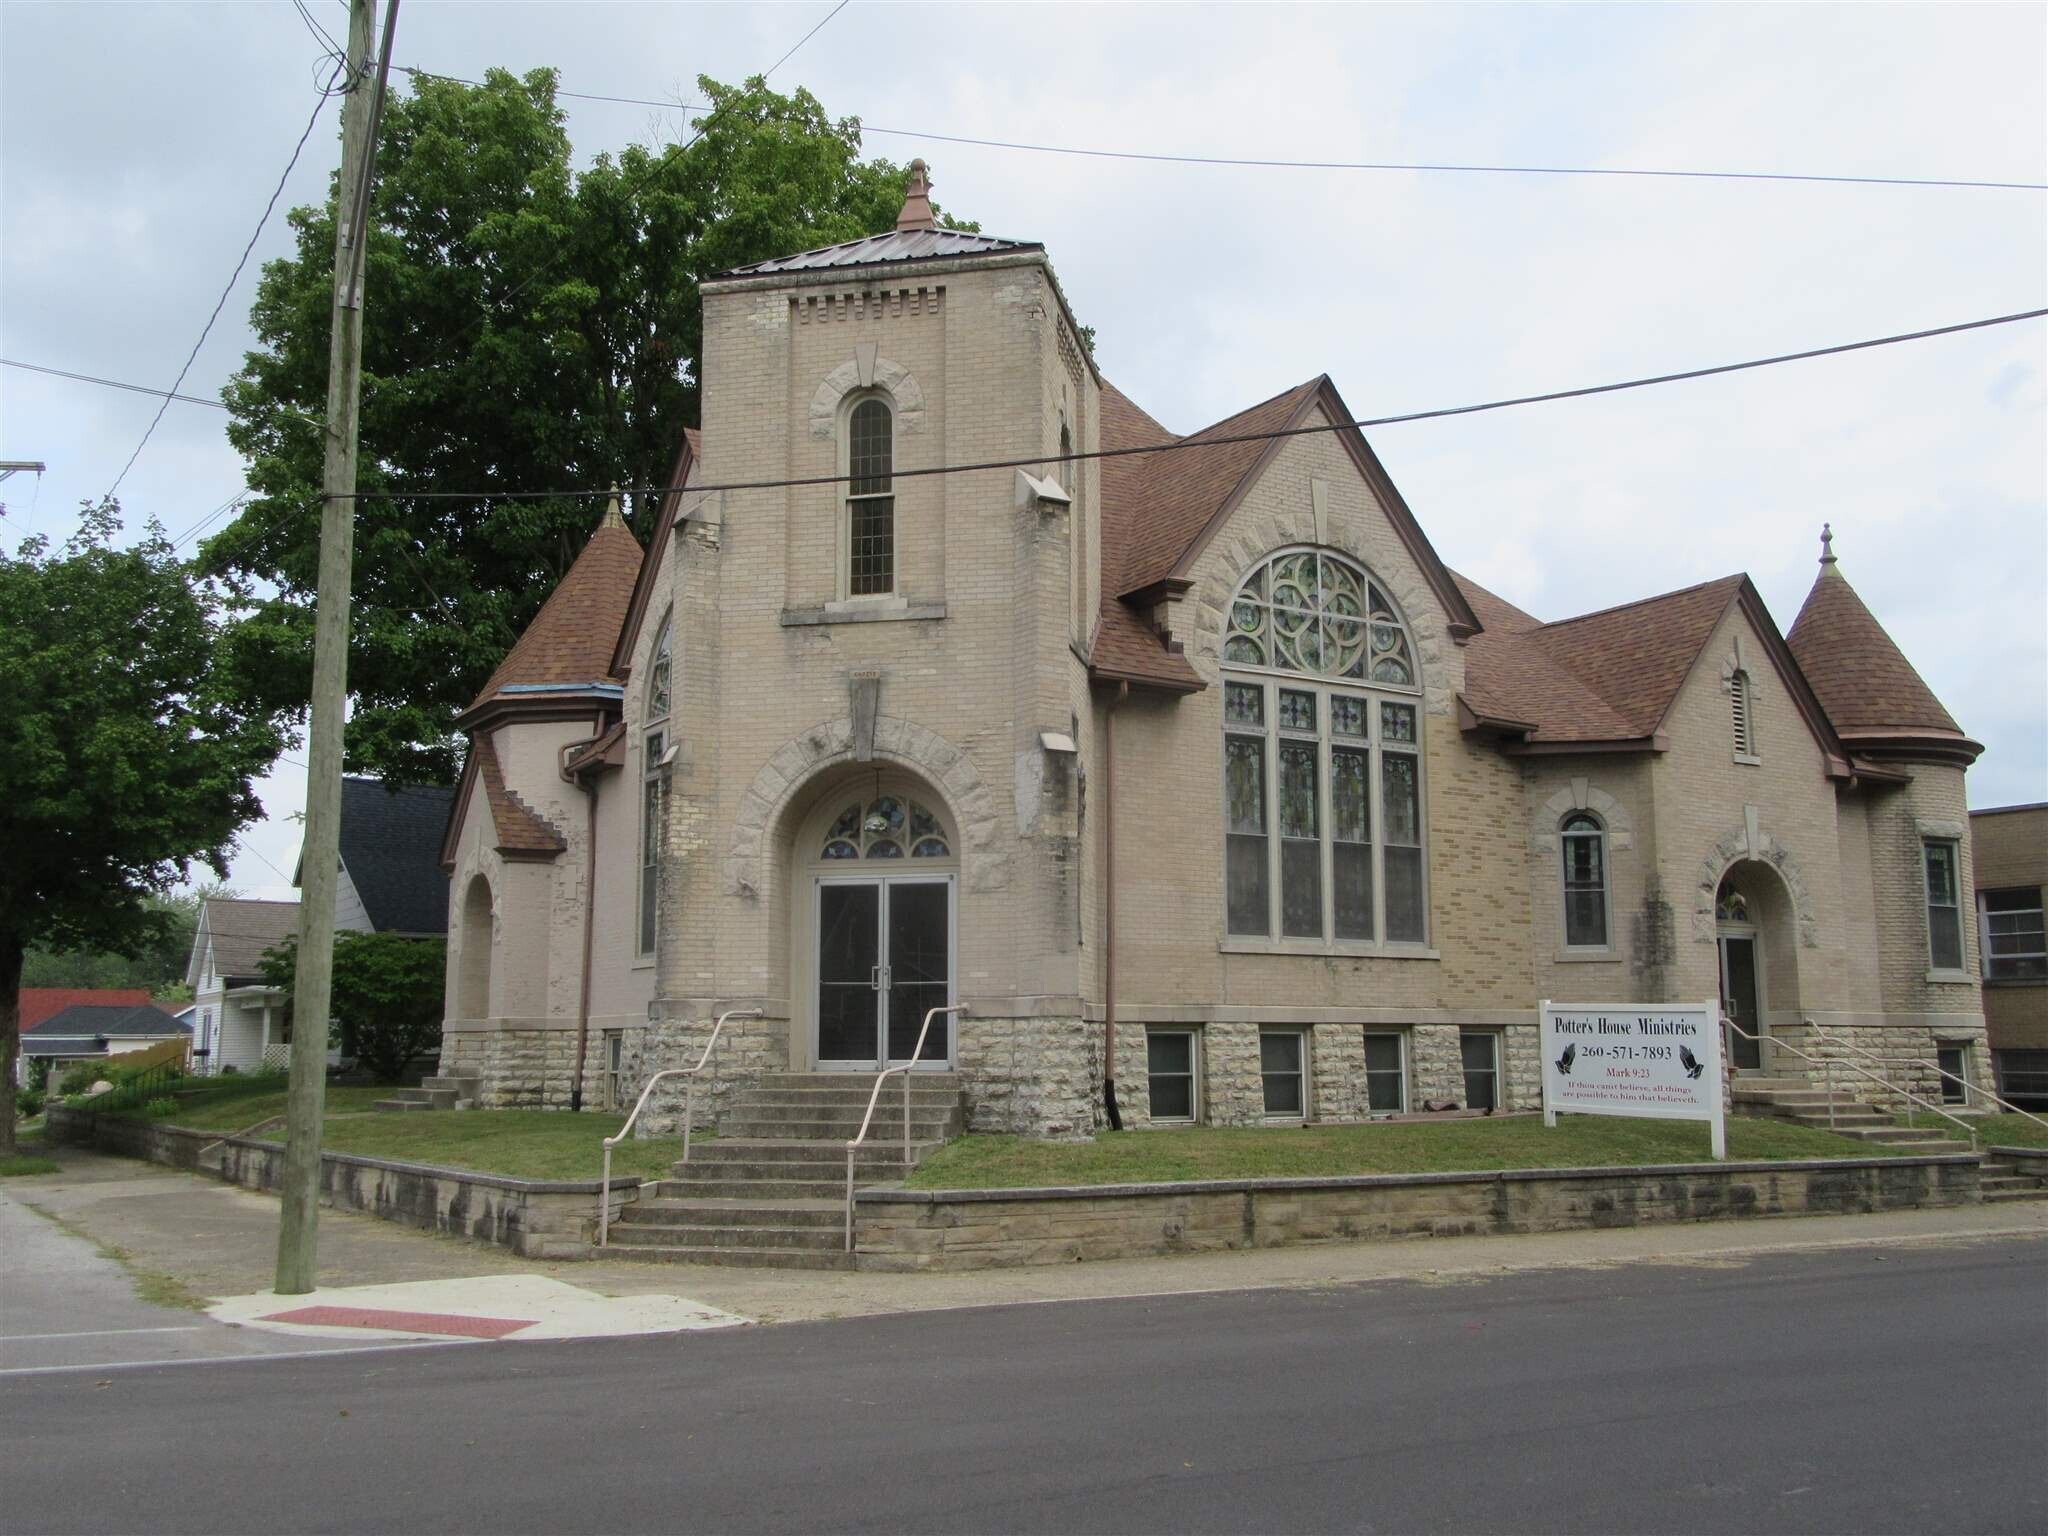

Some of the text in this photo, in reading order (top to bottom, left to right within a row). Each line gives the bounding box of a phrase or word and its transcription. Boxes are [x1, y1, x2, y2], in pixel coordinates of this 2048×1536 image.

[1555, 1016, 1697, 1035] Potter's House Ministries
[1581, 1046, 1672, 1060] 260-571-7893
[1606, 1068, 1650, 1079] Mark 9:23
[1568, 1081, 1575, 1089] If
[1576, 1081, 1595, 1090] thou
[1652, 1084, 1663, 1092] all
[1664, 1085, 1692, 1094] things
[1576, 1091, 1608, 1100] possible
[1620, 1092, 1637, 1100] him
[1638, 1093, 1655, 1101] that
